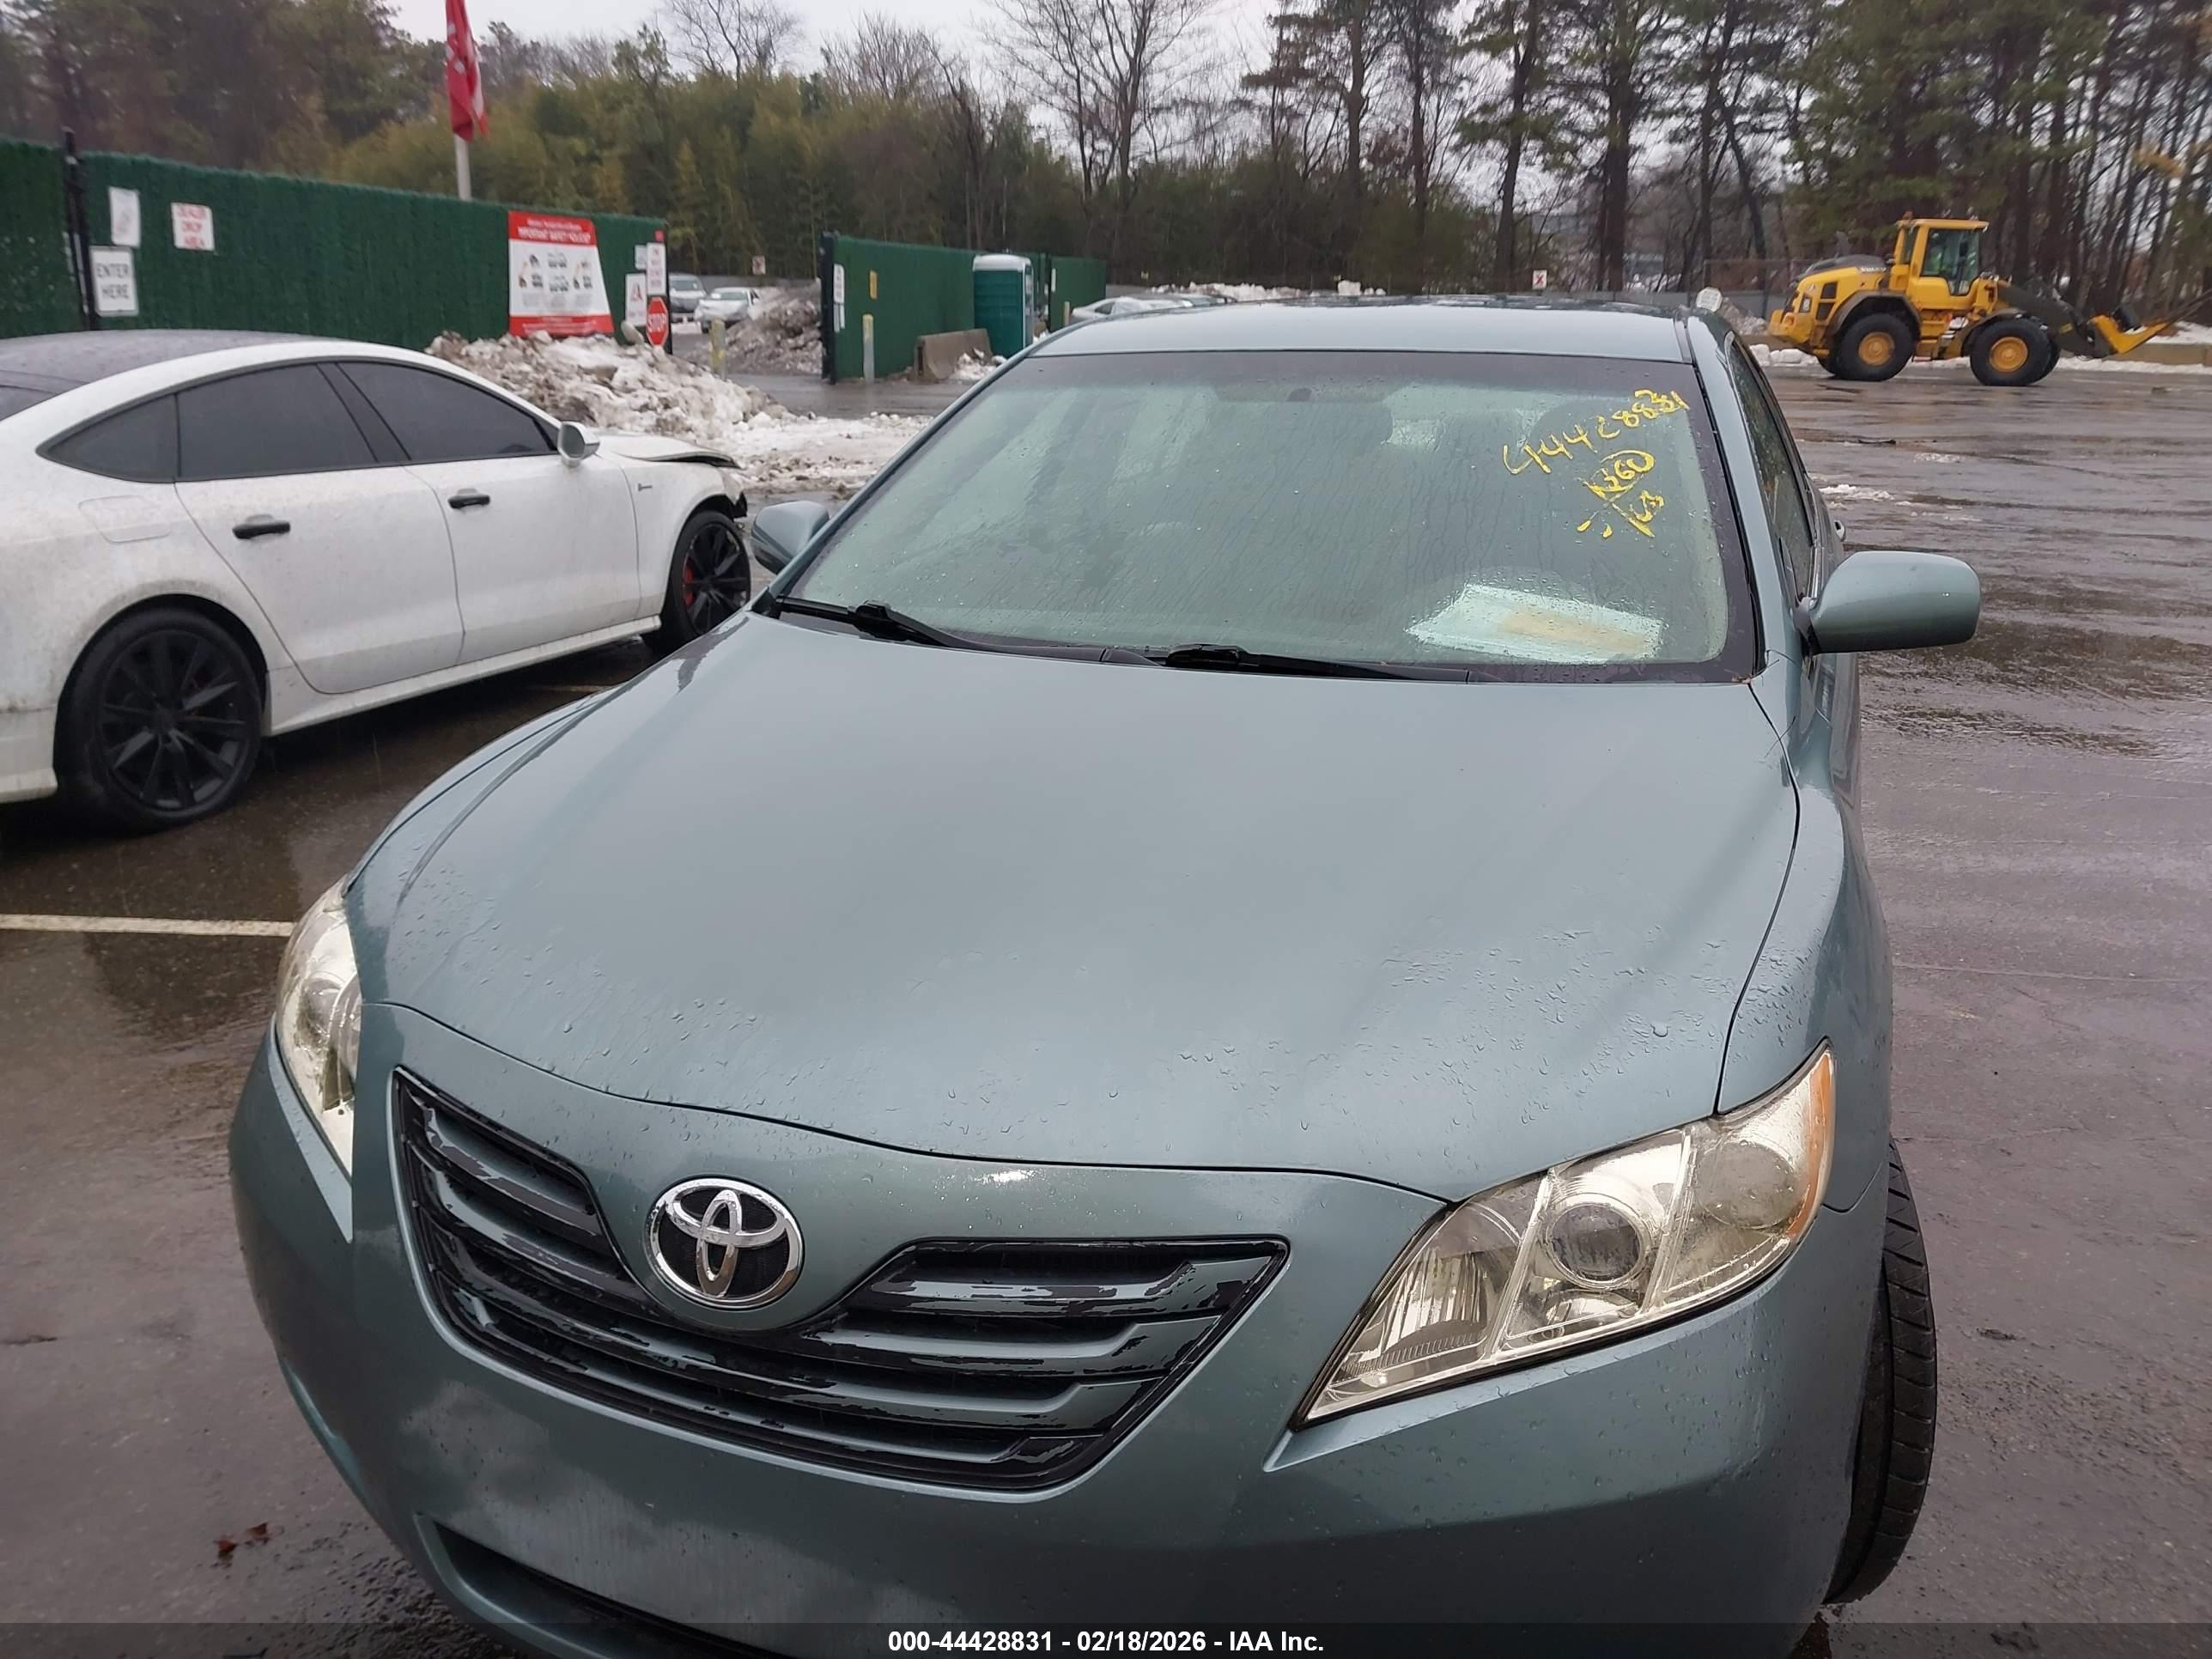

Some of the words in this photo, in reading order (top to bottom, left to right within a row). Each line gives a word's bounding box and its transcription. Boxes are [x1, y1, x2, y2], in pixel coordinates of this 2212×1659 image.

[96, 263, 129, 278] ENTER
[102, 284, 129, 299] HERE
[647, 313, 667, 332] STOP
